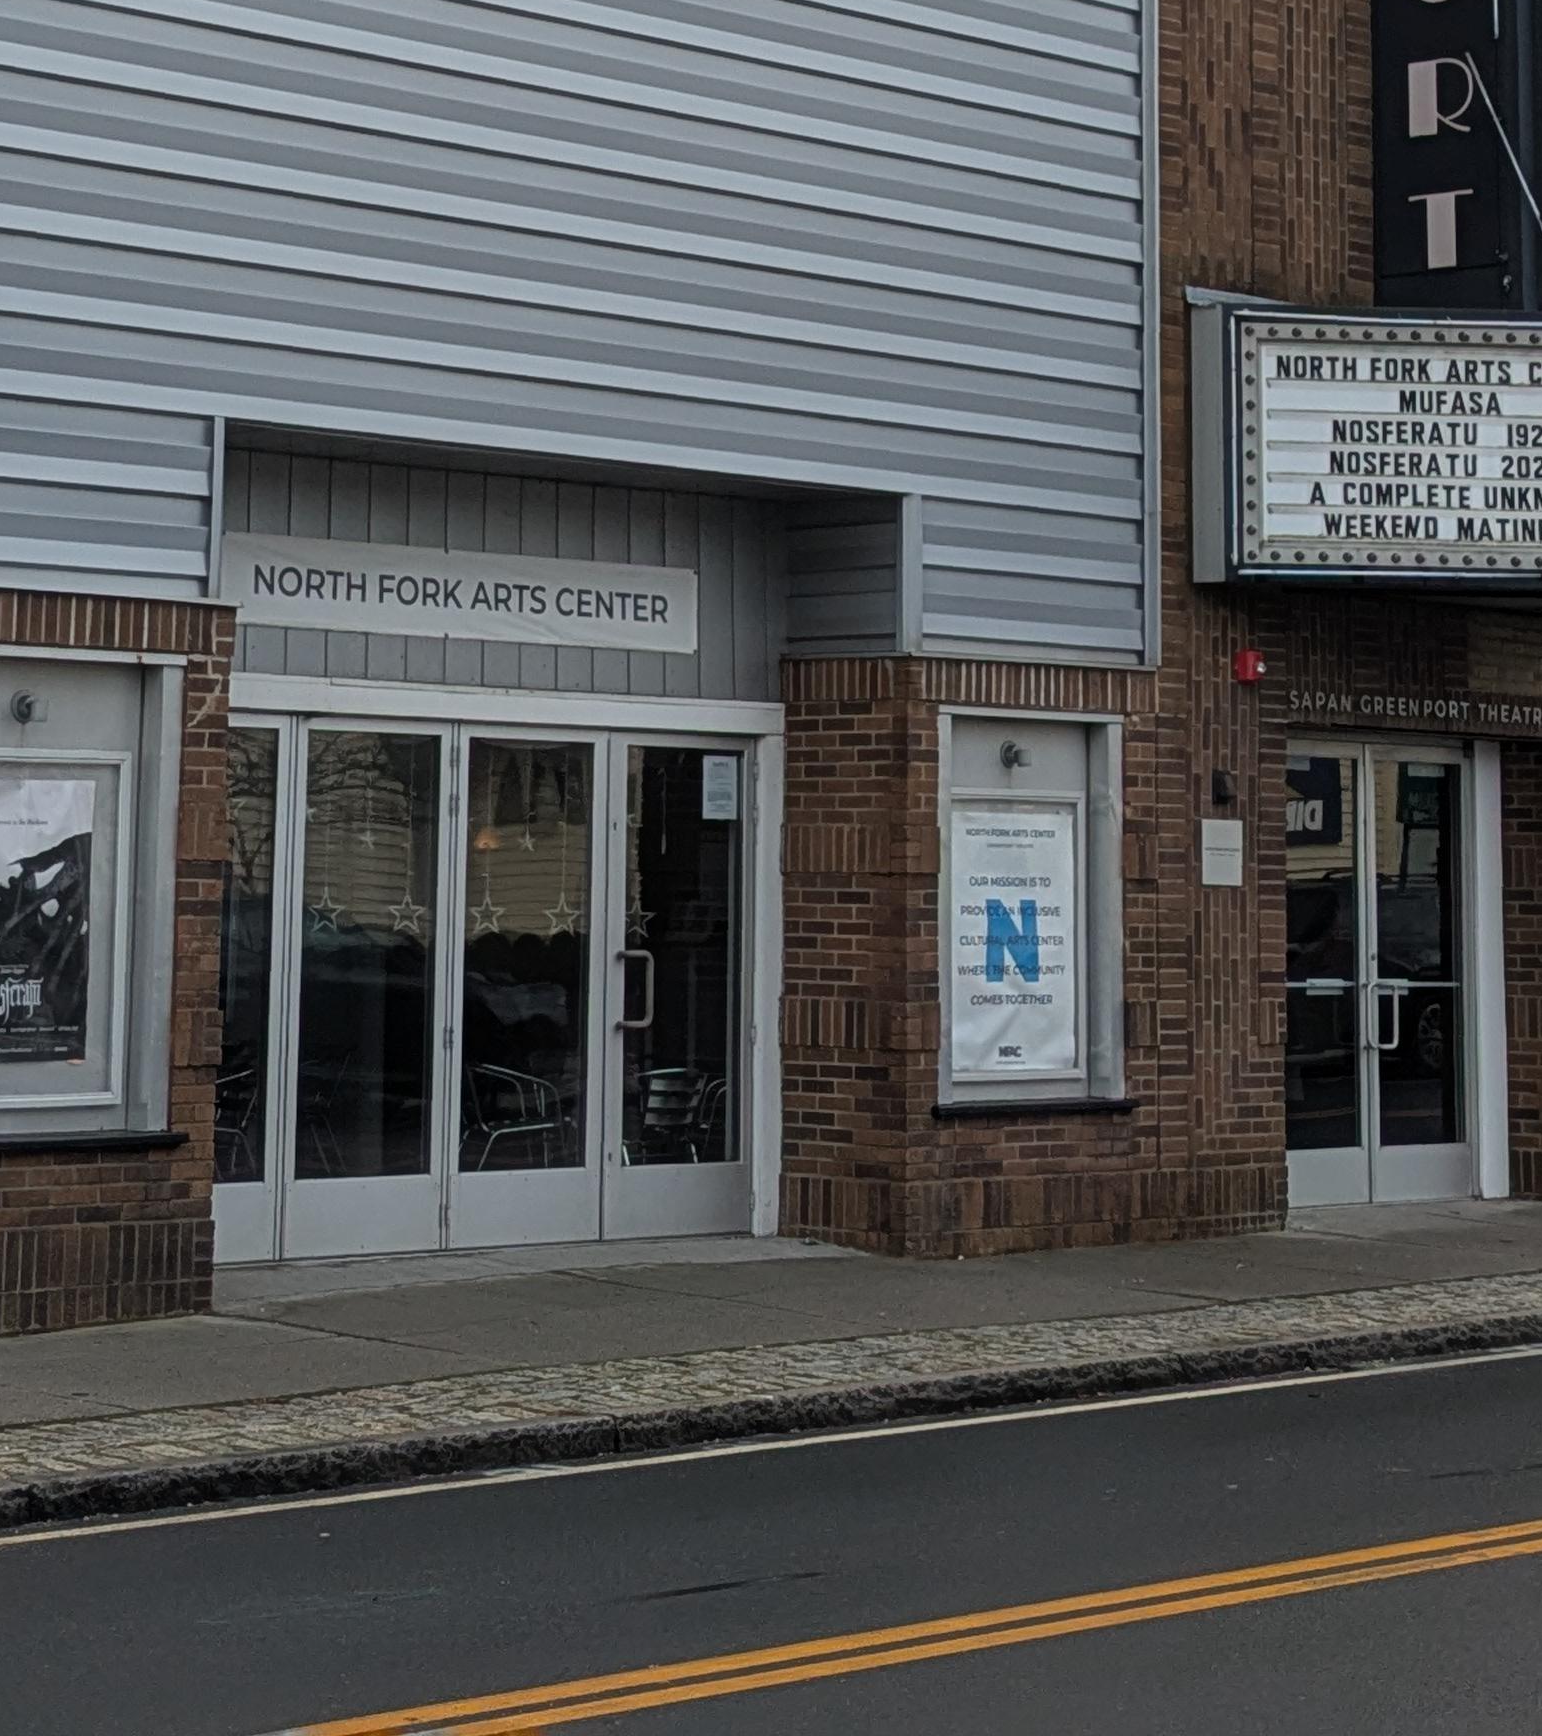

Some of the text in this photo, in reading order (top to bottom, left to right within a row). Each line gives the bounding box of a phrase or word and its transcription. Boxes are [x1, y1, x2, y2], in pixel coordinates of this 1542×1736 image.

[1276, 355, 1358, 382] NORTH
[1370, 357, 1432, 383] FORK
[1445, 359, 1512, 384] ARTS
[1398, 390, 1502, 416] MUFASA
[1331, 420, 1479, 447] NOSFERATU
[1328, 451, 1479, 478] NOSFERATU
[1309, 483, 1326, 506] A
[1342, 483, 1471, 510] COMPLETE
[1323, 513, 1439, 540] WEEKEND
[253, 564, 669, 624] NORTH FORK ARTS CENTER
[1289, 689, 1353, 713] SAPAN
[1360, 694, 1470, 721] GREENPORT
[969, 876, 1052, 888] OUR MISSION IS TO
[959, 935, 1065, 946] CULTURAL ARTS CENTER
[985, 898, 1040, 983] N
[970, 994, 1054, 1006] COMES TOGETHER
